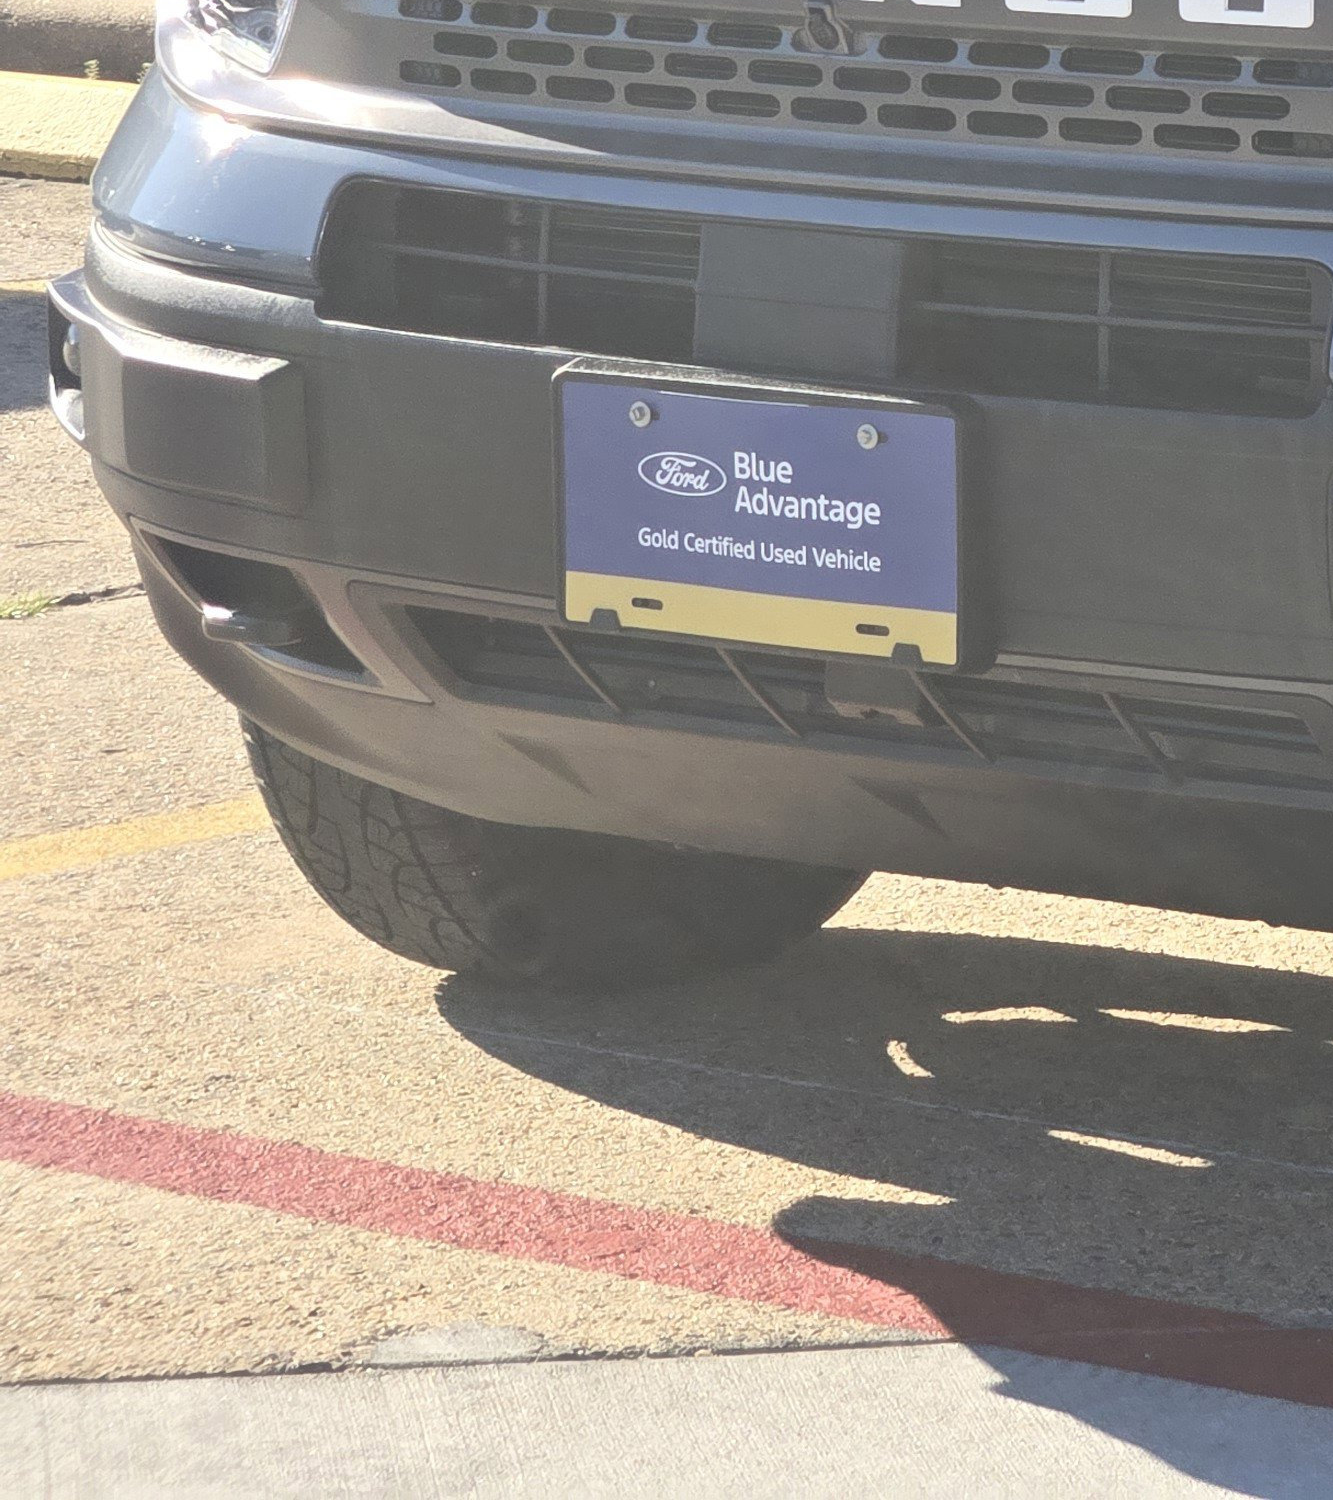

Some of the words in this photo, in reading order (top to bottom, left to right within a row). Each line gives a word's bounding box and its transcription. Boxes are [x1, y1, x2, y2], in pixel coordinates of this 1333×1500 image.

[733, 451, 794, 485] Blue
[734, 486, 882, 530] Advantage
[638, 526, 679, 550] Gold
[683, 532, 755, 560] Certified
[760, 542, 807, 566] Used
[812, 547, 882, 573] Vehicle
